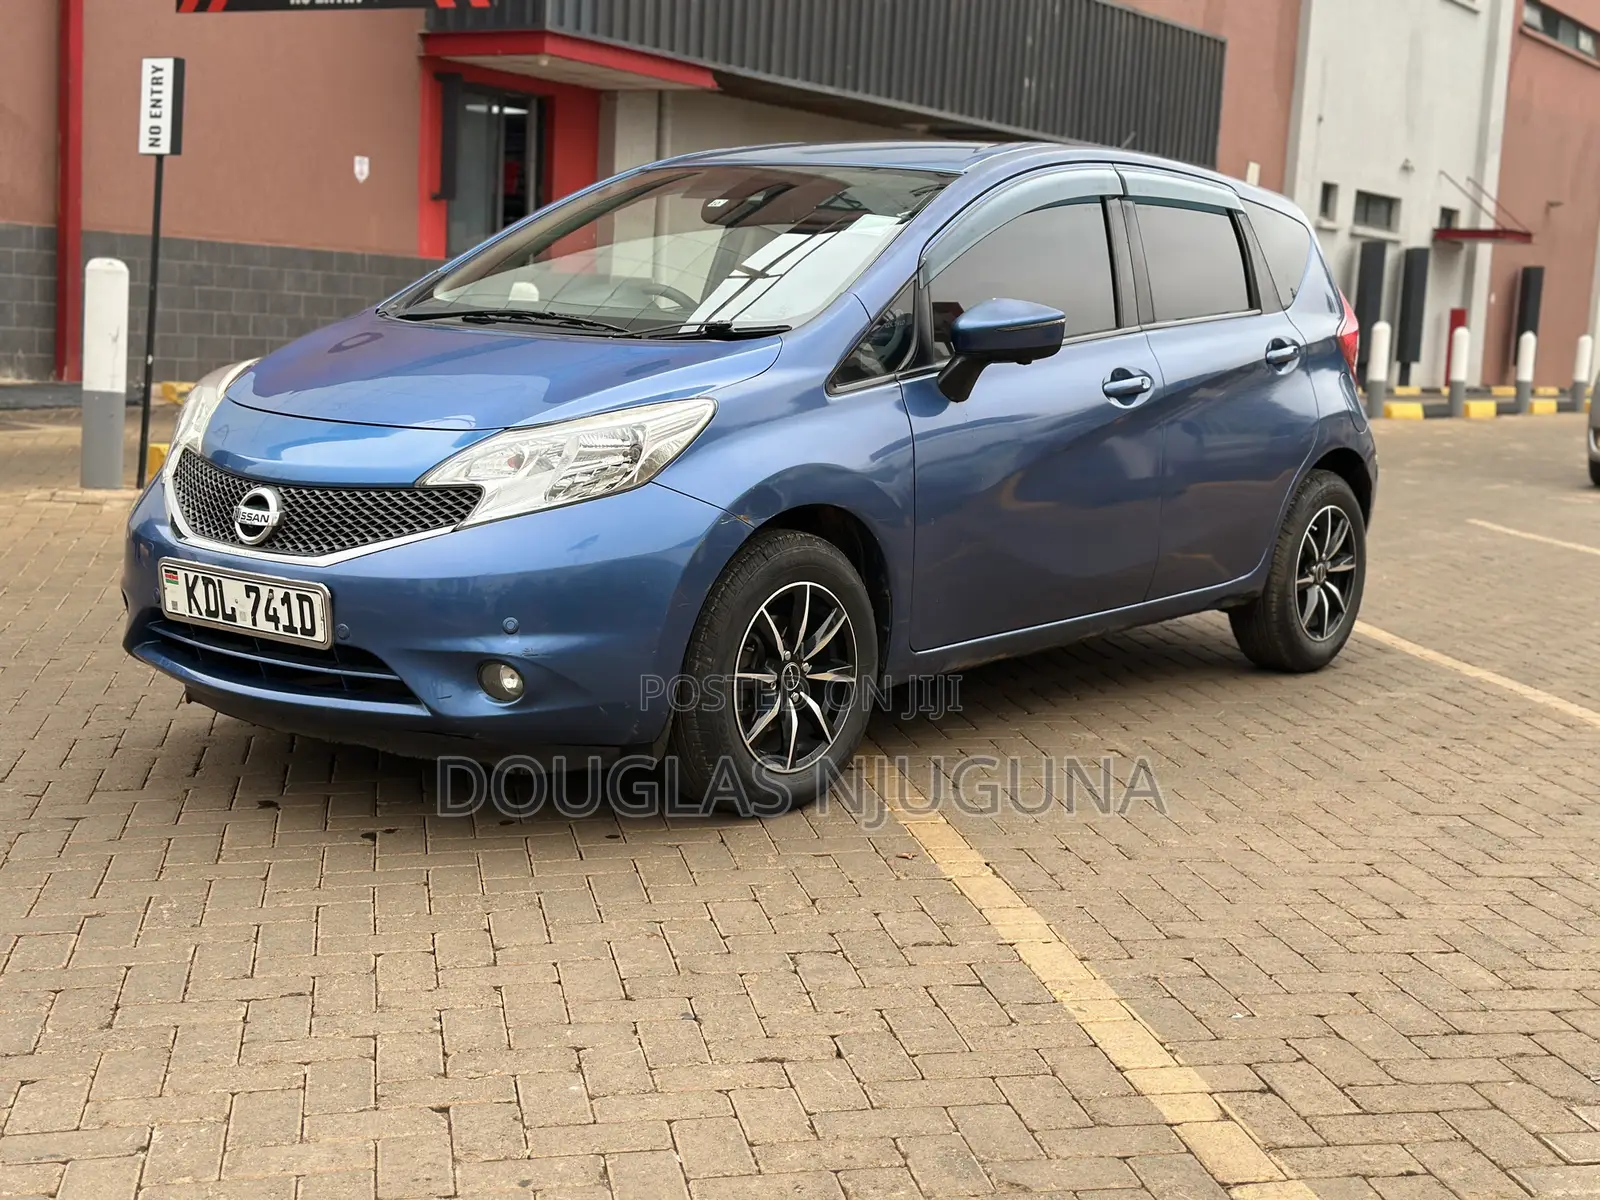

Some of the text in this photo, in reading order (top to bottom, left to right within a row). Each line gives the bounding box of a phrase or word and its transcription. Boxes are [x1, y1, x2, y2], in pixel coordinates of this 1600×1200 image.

[148, 65, 164, 148] NO ENTRY
[184, 572, 316, 637] KDL 741D
